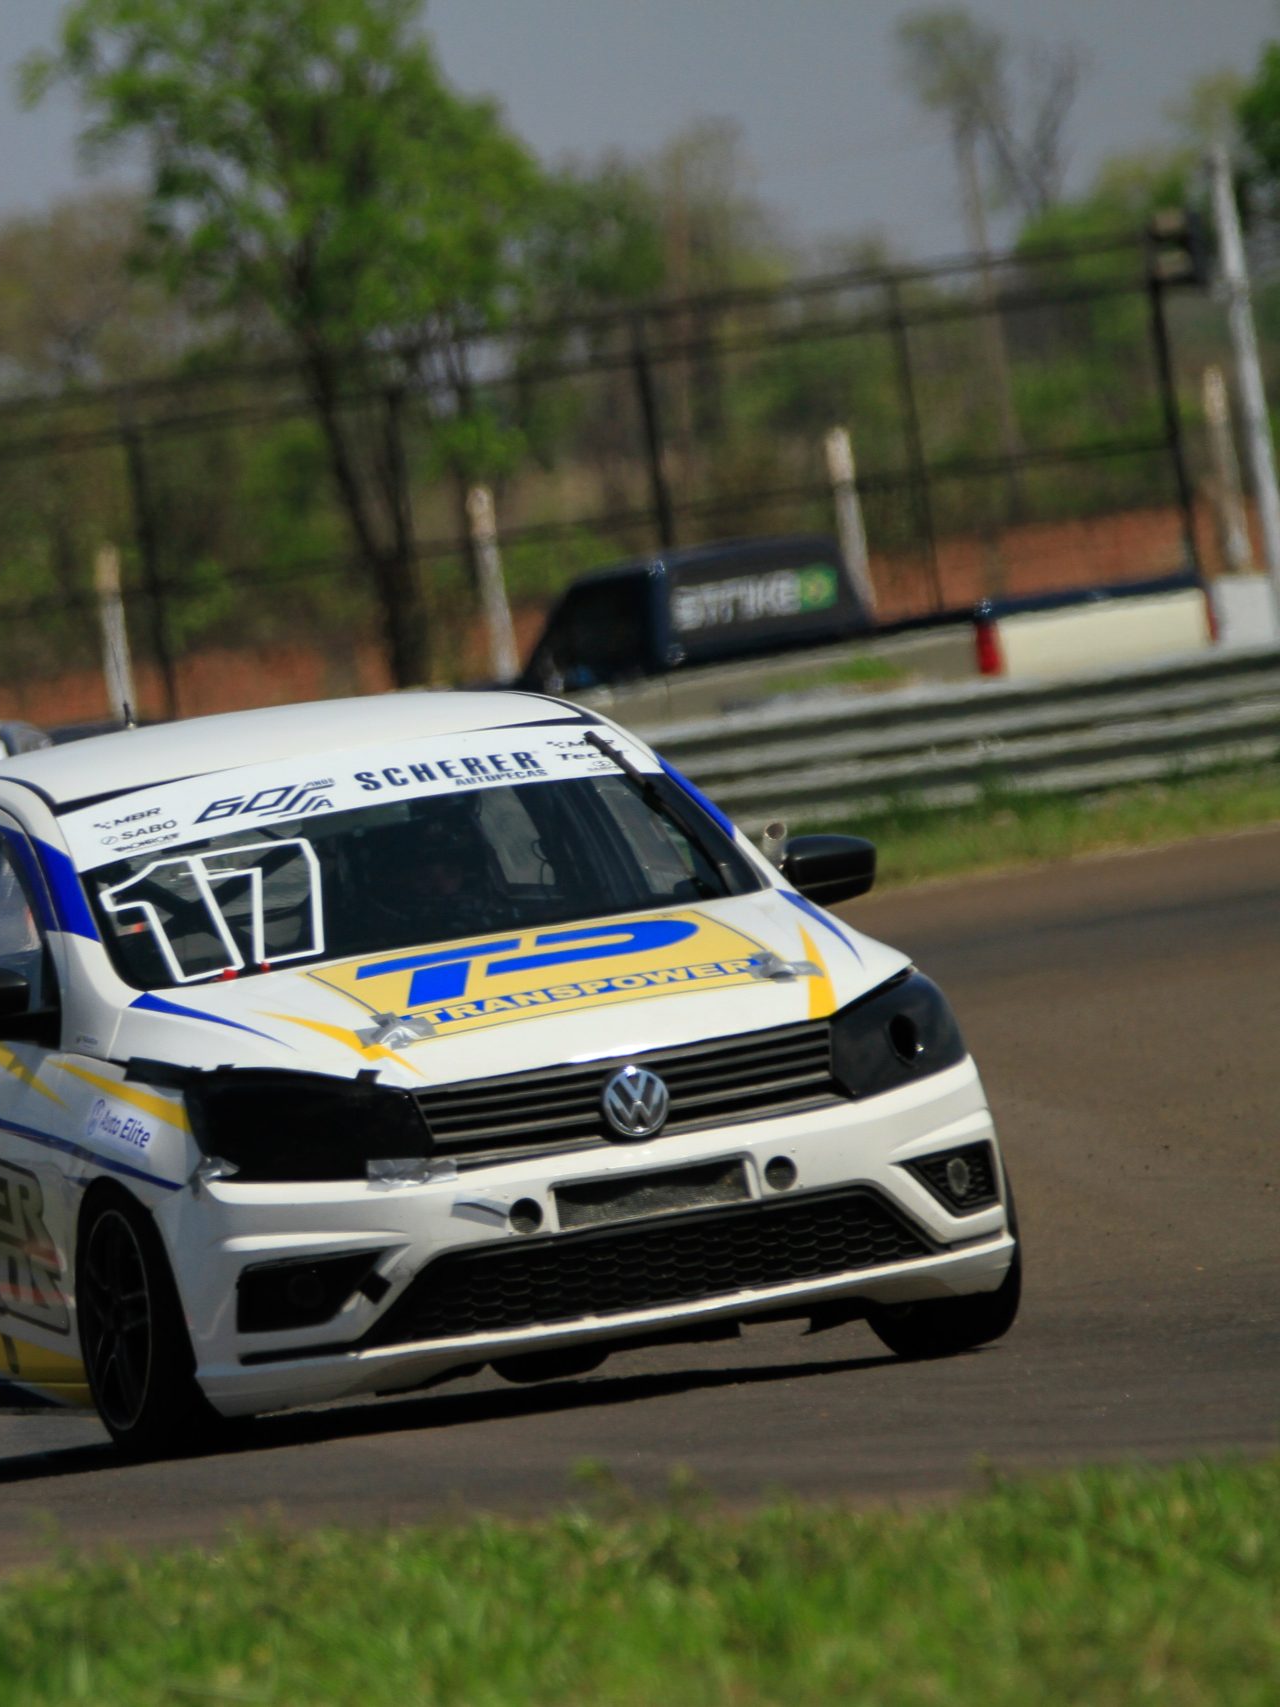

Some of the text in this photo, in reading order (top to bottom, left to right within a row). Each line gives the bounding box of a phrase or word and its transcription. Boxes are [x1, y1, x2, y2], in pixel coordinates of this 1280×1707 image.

[353, 751, 542, 792] SCHERER
[113, 807, 162, 827] MBR
[100, 838, 324, 984] 17
[412, 959, 754, 1024] TRANSPOWER
[120, 1117, 151, 1149] Elite
